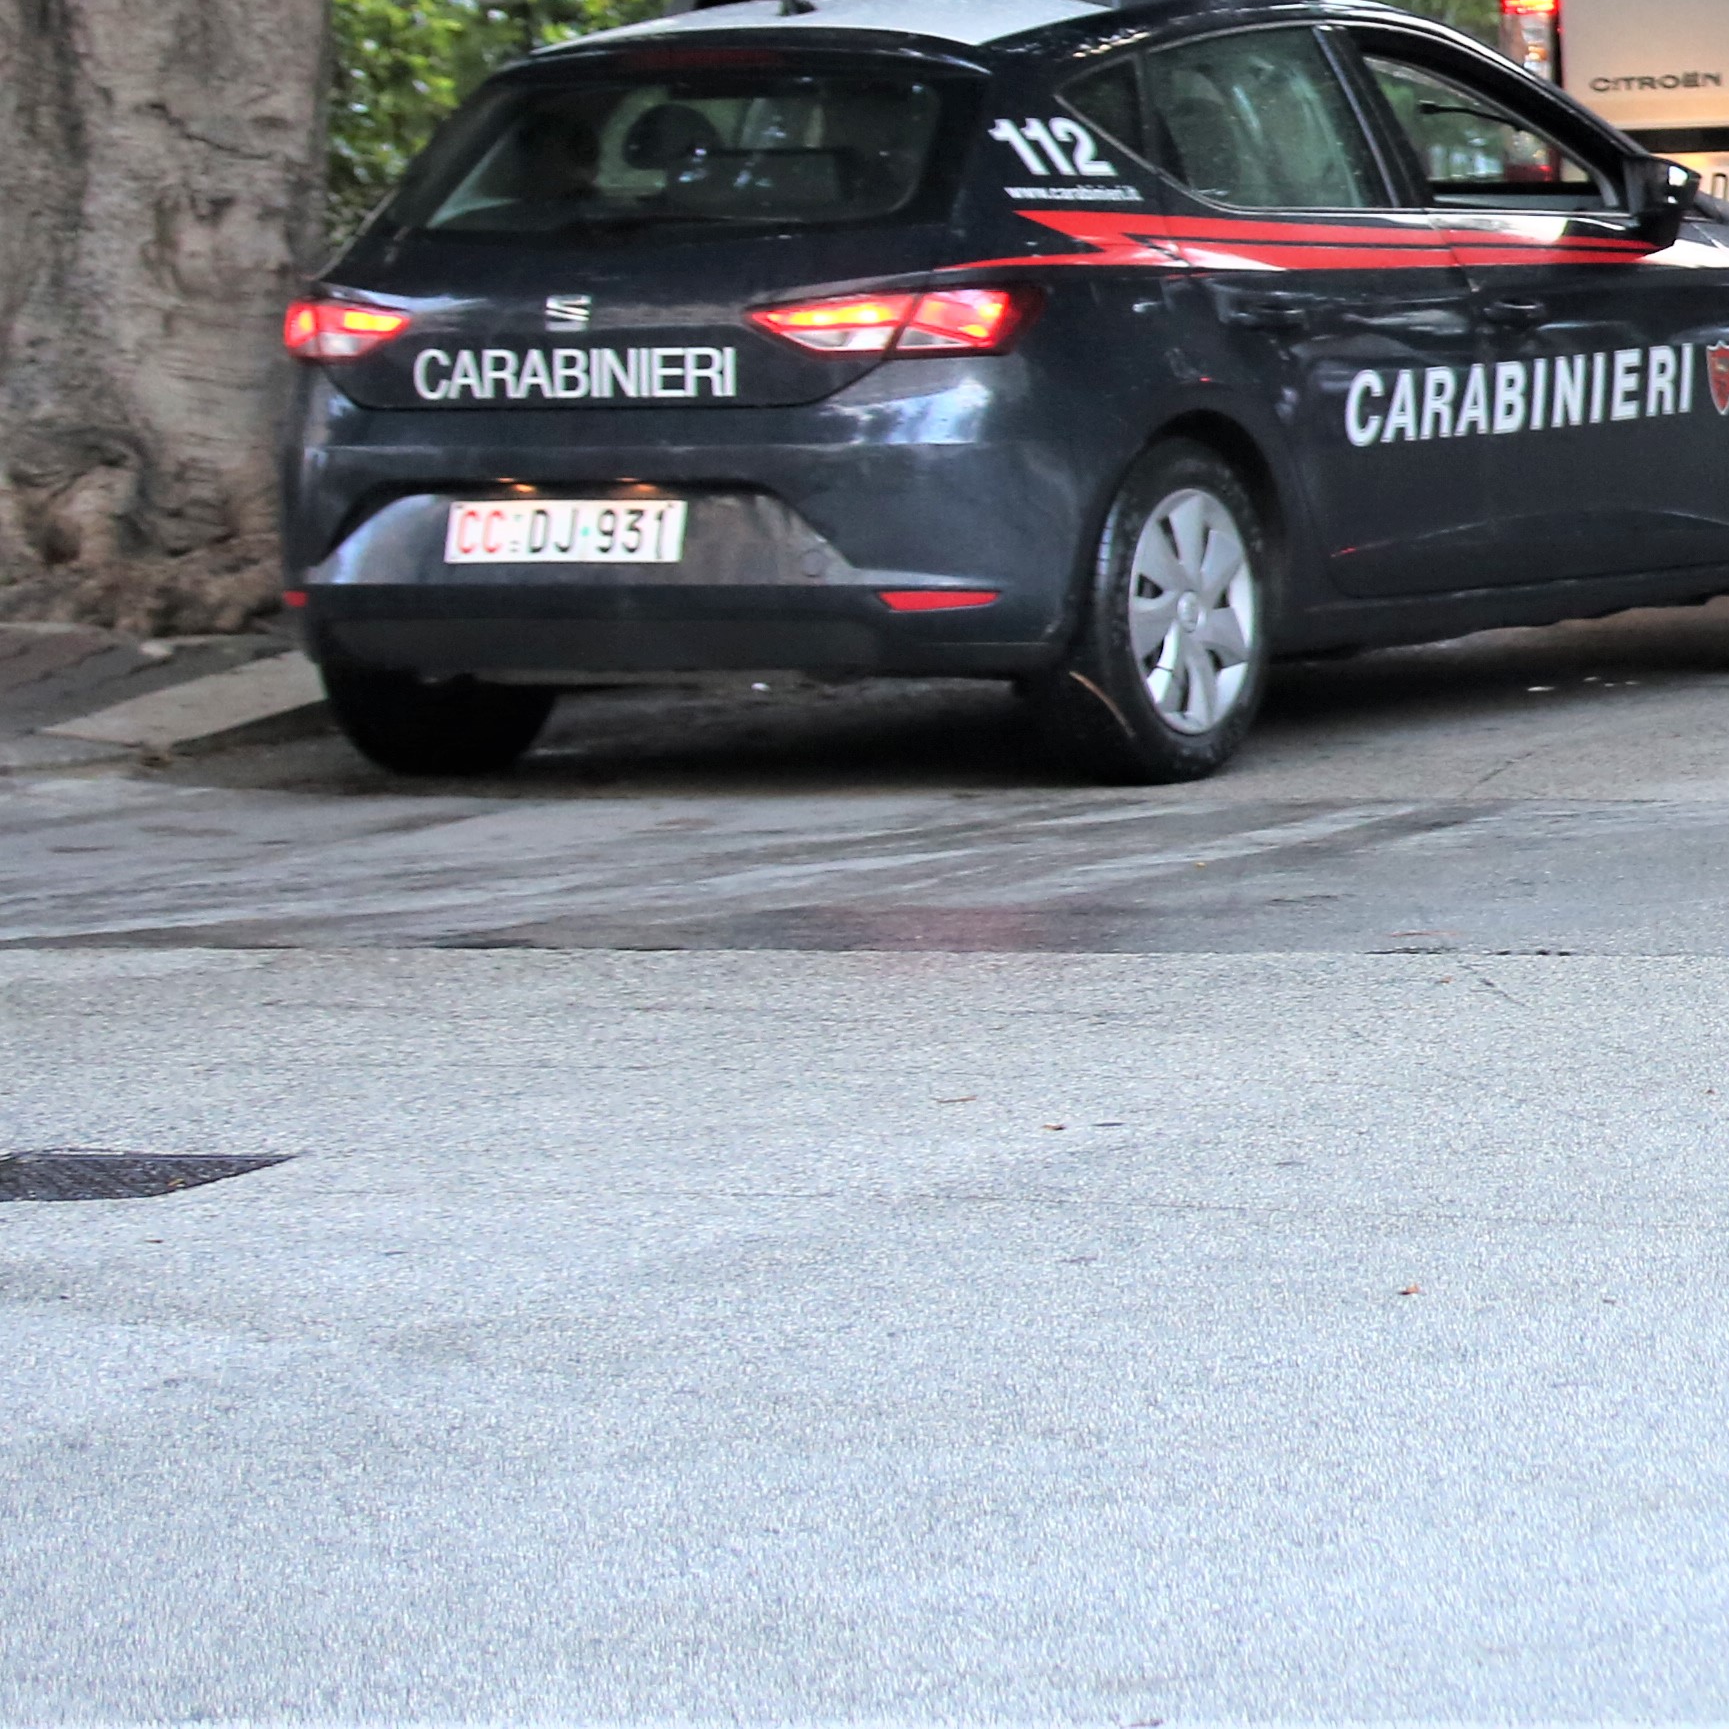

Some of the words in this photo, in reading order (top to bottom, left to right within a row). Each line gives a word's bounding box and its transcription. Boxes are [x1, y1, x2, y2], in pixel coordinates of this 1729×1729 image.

[987, 116, 1119, 176] 112
[413, 346, 738, 400] CARABINIERI
[1344, 342, 1695, 447] CARABINIERI
[457, 509, 506, 555] CC
[528, 508, 580, 554] DJ
[596, 507, 668, 560] 931
